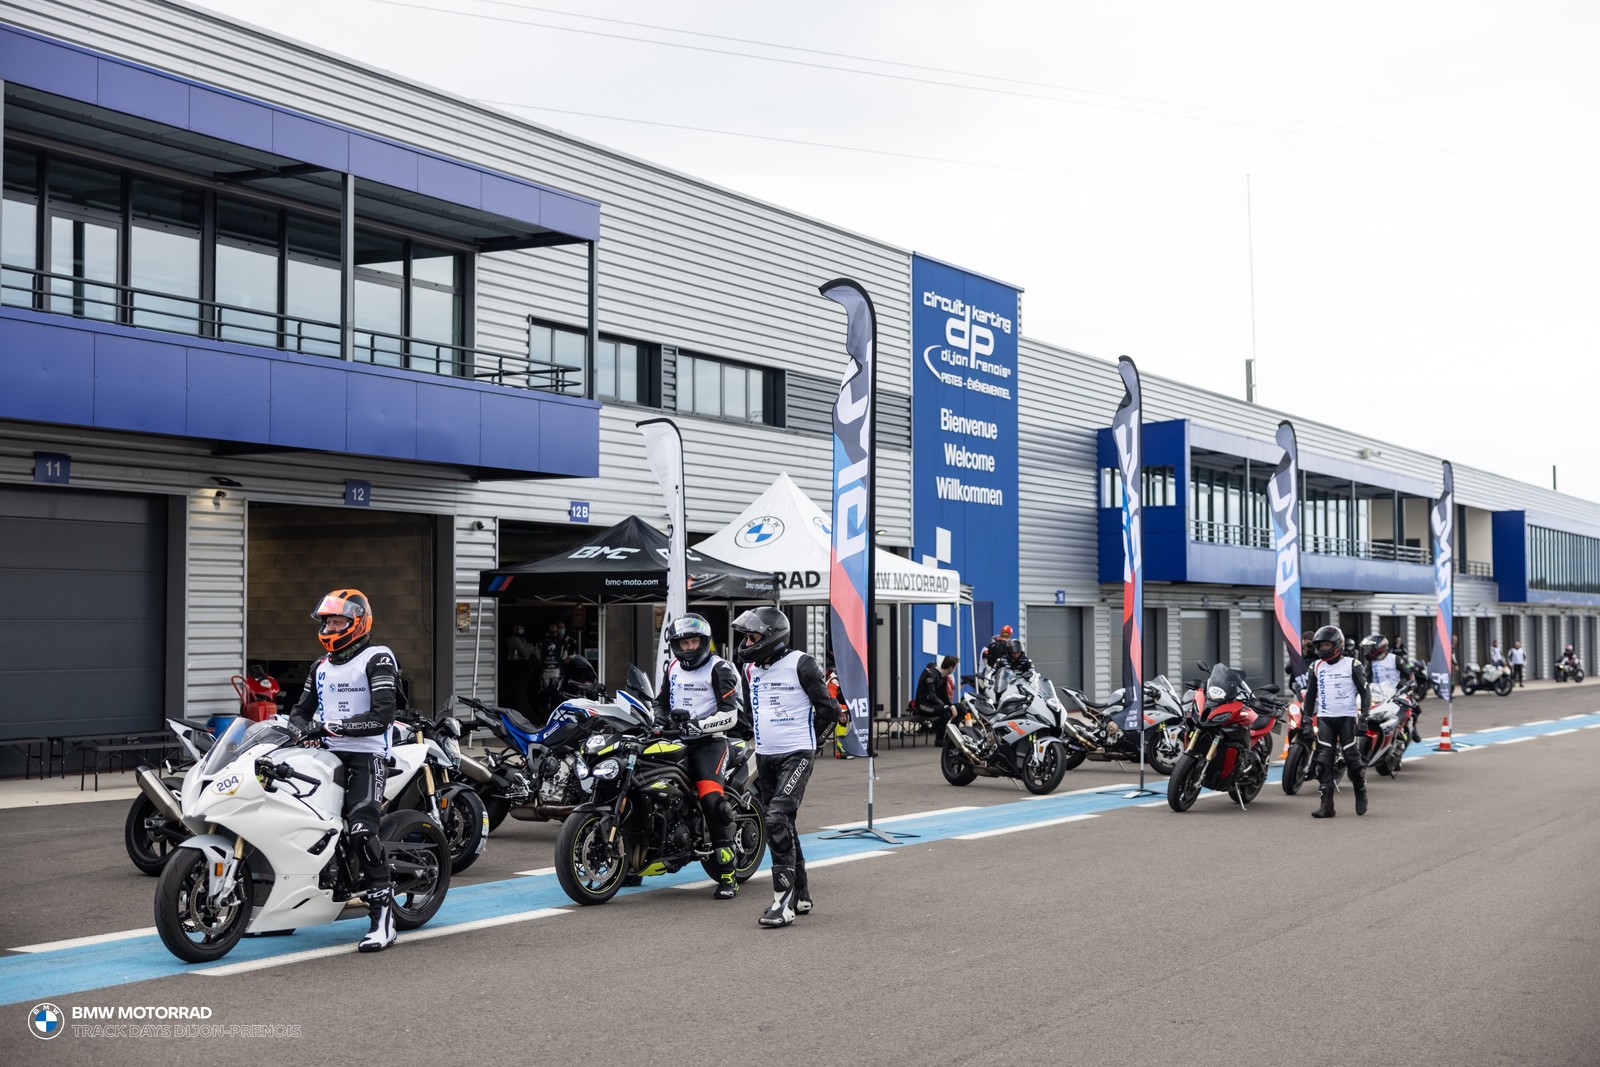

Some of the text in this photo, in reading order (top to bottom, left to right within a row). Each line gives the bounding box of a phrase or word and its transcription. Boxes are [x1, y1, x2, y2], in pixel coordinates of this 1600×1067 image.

[923, 291, 1011, 334] circuit karting
[941, 349, 969, 367] dijon
[941, 372, 962, 388] PISTES
[940, 407, 998, 440] Bienvenue
[944, 443, 996, 473] Welcome
[46, 461, 60, 477] 11
[352, 488, 364, 501] 12
[936, 476, 1003, 506] Willkommen
[572, 505, 588, 518] 12B
[568, 546, 641, 560] BMC
[605, 577, 659, 586] bmc-moto.com
[893, 573, 949, 593] MOTORRAD
[752, 676, 762, 746] TRACKDAYS
[216, 775, 239, 792] 204
[784, 758, 809, 795] BERING
